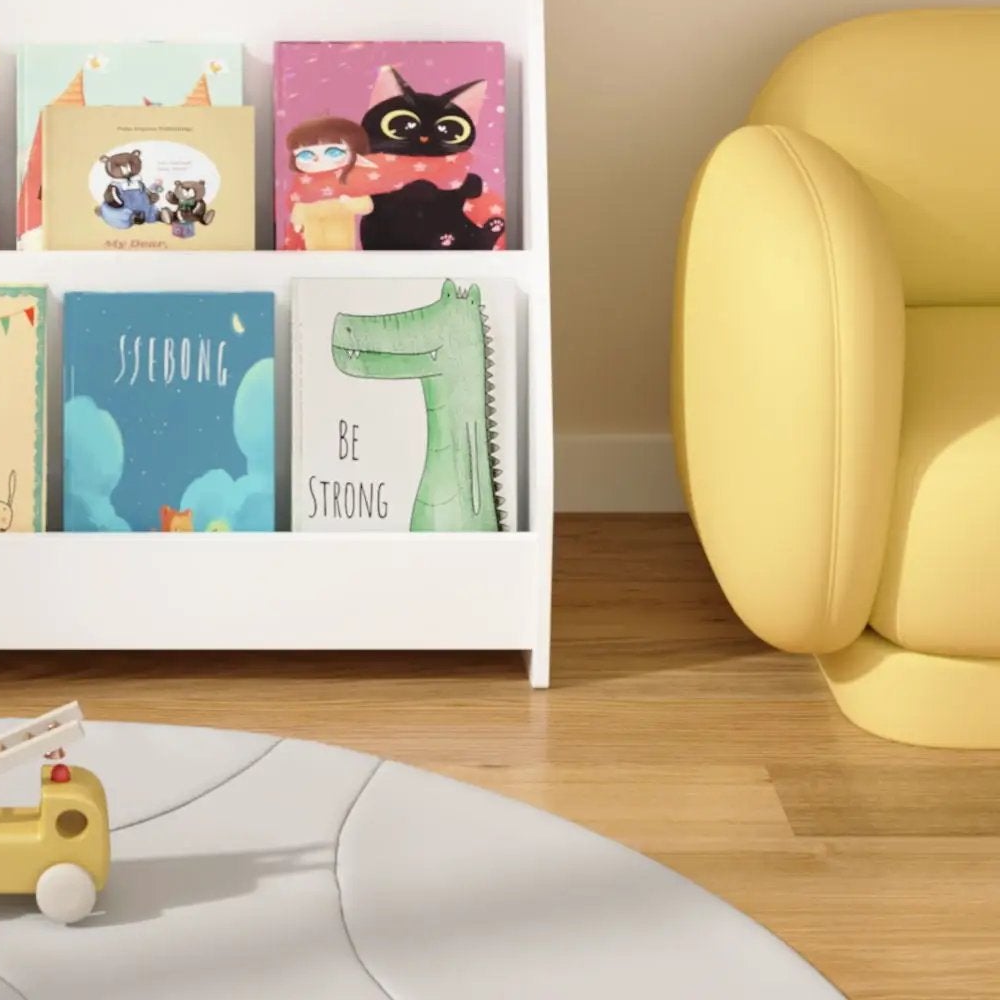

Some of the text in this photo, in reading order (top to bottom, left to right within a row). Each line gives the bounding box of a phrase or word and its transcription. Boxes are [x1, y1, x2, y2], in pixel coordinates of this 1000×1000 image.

[113, 334, 228, 387] SSEBONG
[338, 418, 361, 461] BE
[308, 475, 389, 520] STRONG
